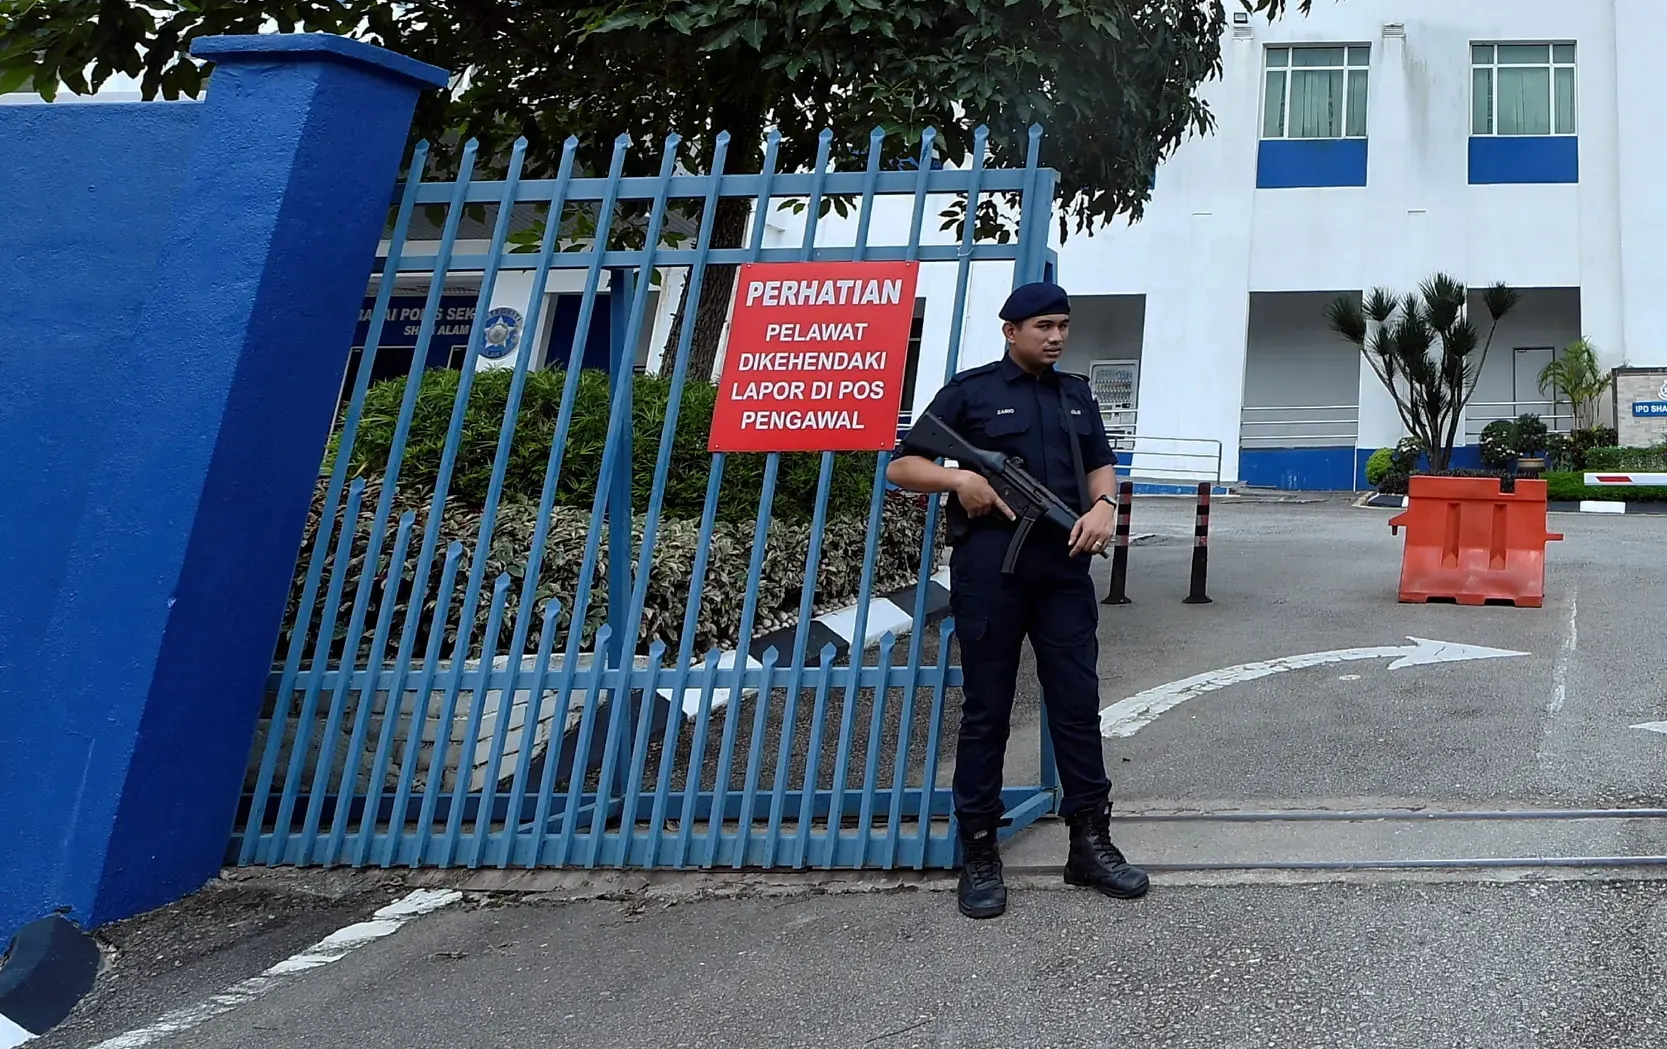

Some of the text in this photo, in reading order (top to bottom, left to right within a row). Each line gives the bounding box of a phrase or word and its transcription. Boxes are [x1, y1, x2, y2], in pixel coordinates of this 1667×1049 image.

[745, 279, 902, 307] PERHATIAN
[437, 325, 470, 335] ALAM
[765, 323, 868, 342] PELAWAT
[738, 351, 887, 371] DIKEHENDAKI
[731, 380, 885, 401] LAPOR DI POS
[1635, 405, 1649, 413] IPD
[740, 411, 865, 430] PENGAWAL
